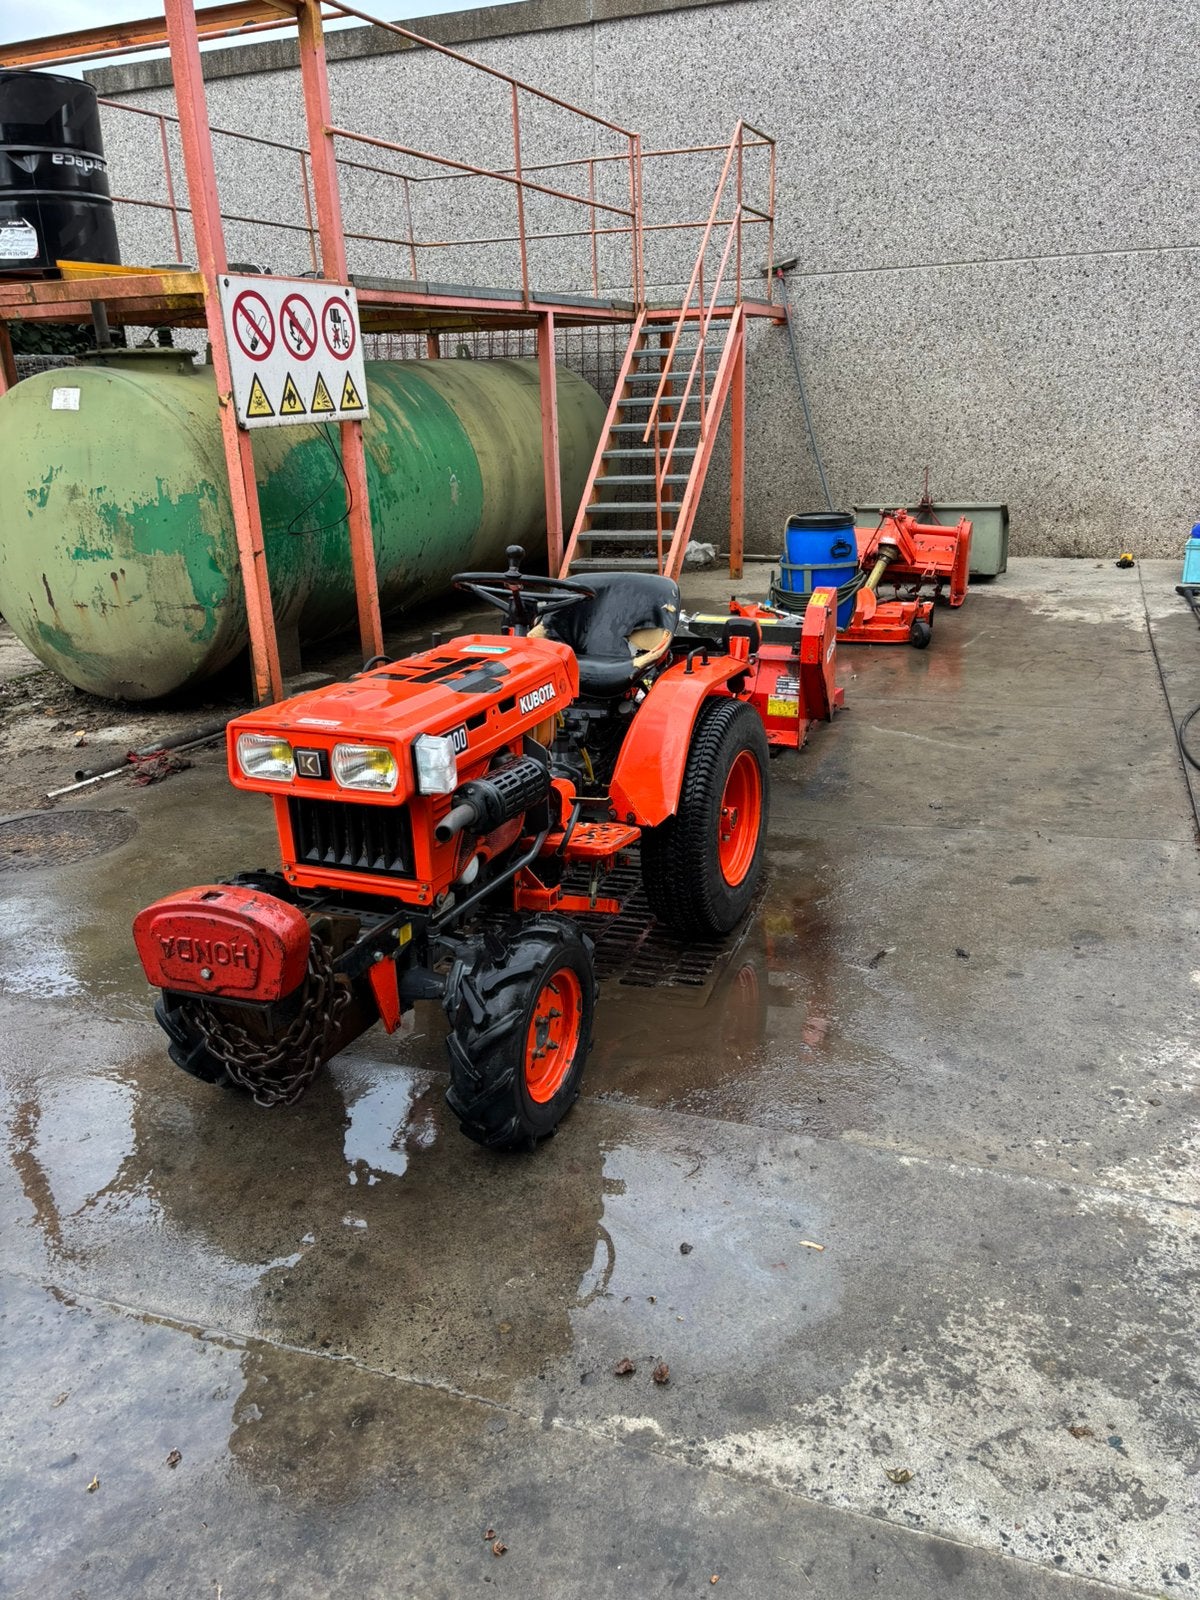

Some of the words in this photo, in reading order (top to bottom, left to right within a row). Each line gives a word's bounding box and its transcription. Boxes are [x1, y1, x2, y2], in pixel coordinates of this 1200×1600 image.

[519, 682, 556, 714] KUBOTA
[301, 755, 316, 773] K
[156, 933, 250, 969] HONDA
